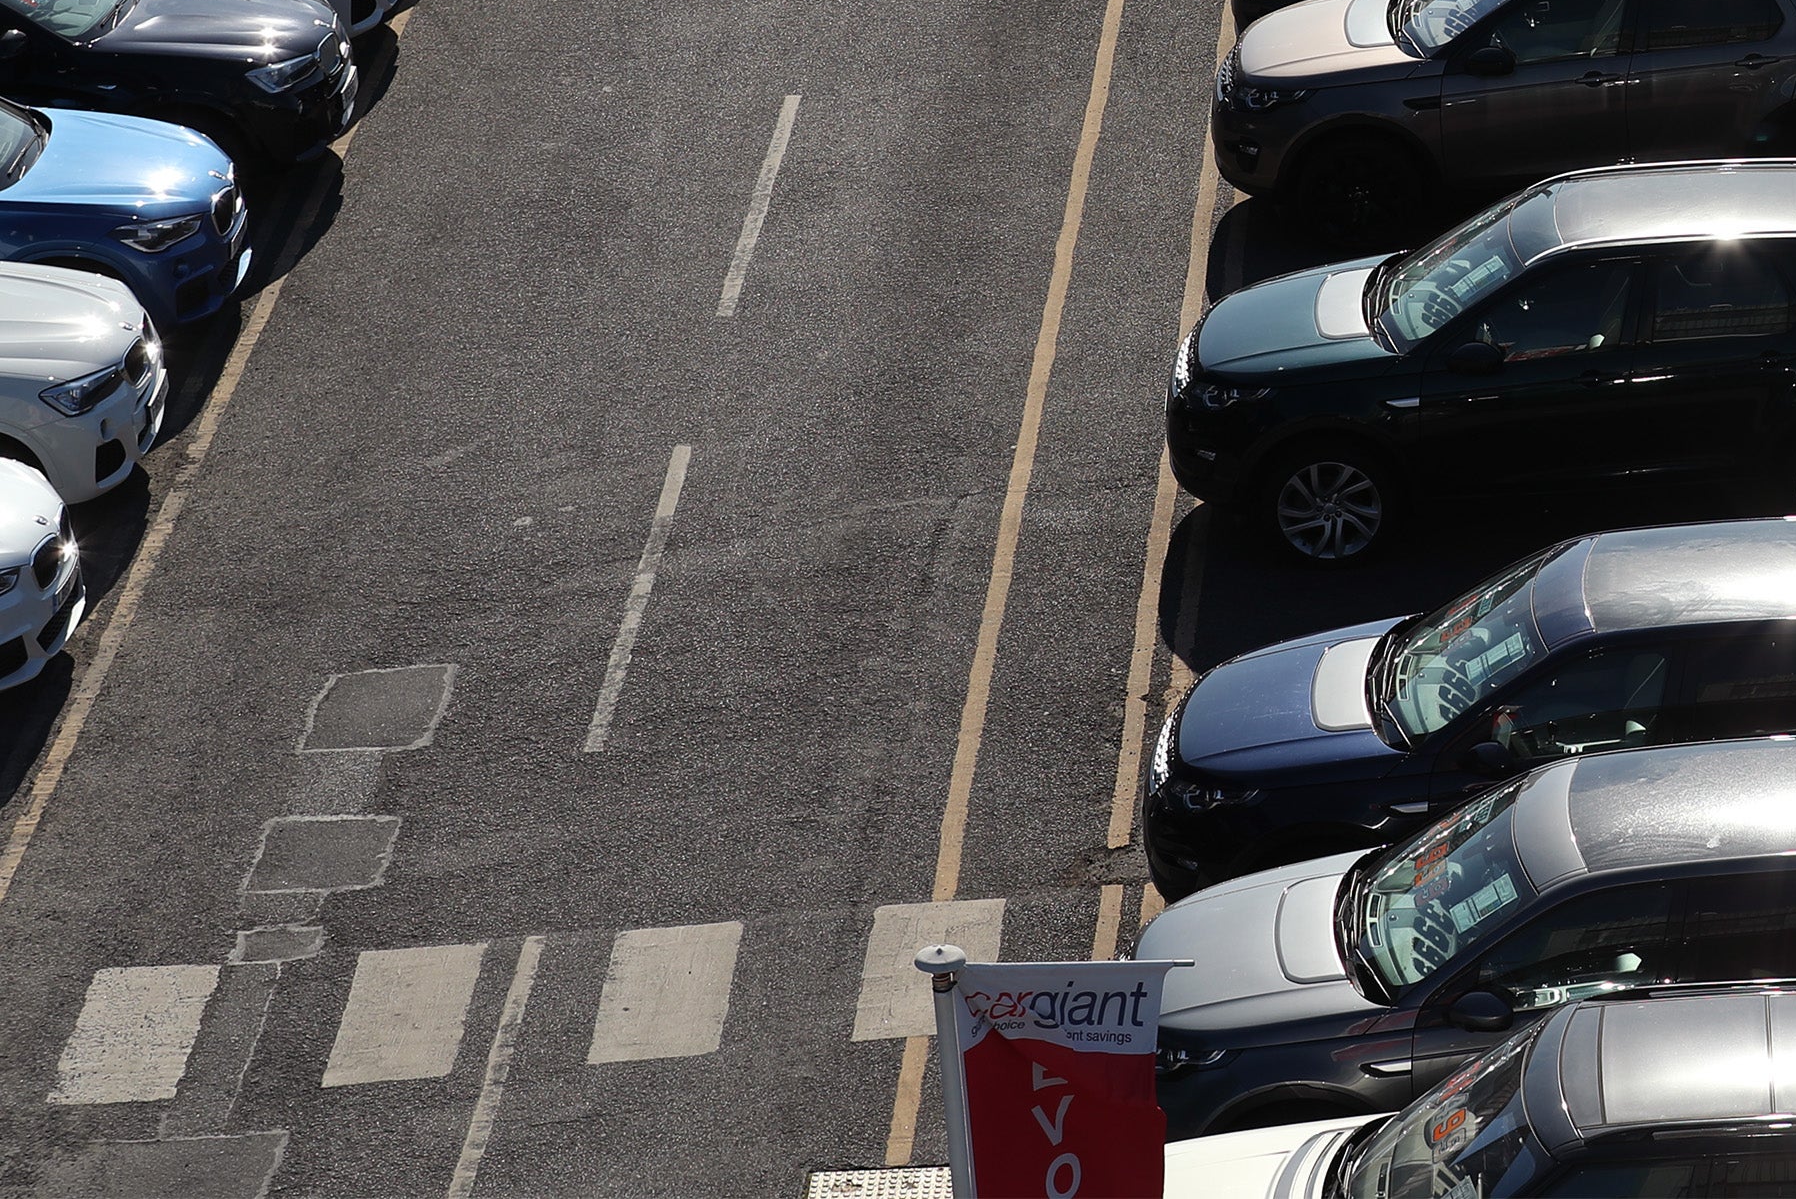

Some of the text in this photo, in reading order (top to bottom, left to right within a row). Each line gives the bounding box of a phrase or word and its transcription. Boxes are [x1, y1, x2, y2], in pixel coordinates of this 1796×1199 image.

[965, 981, 1148, 1030] cargiant
[993, 1020, 1026, 1032] hoice
[1086, 1031, 1132, 1046] savings
